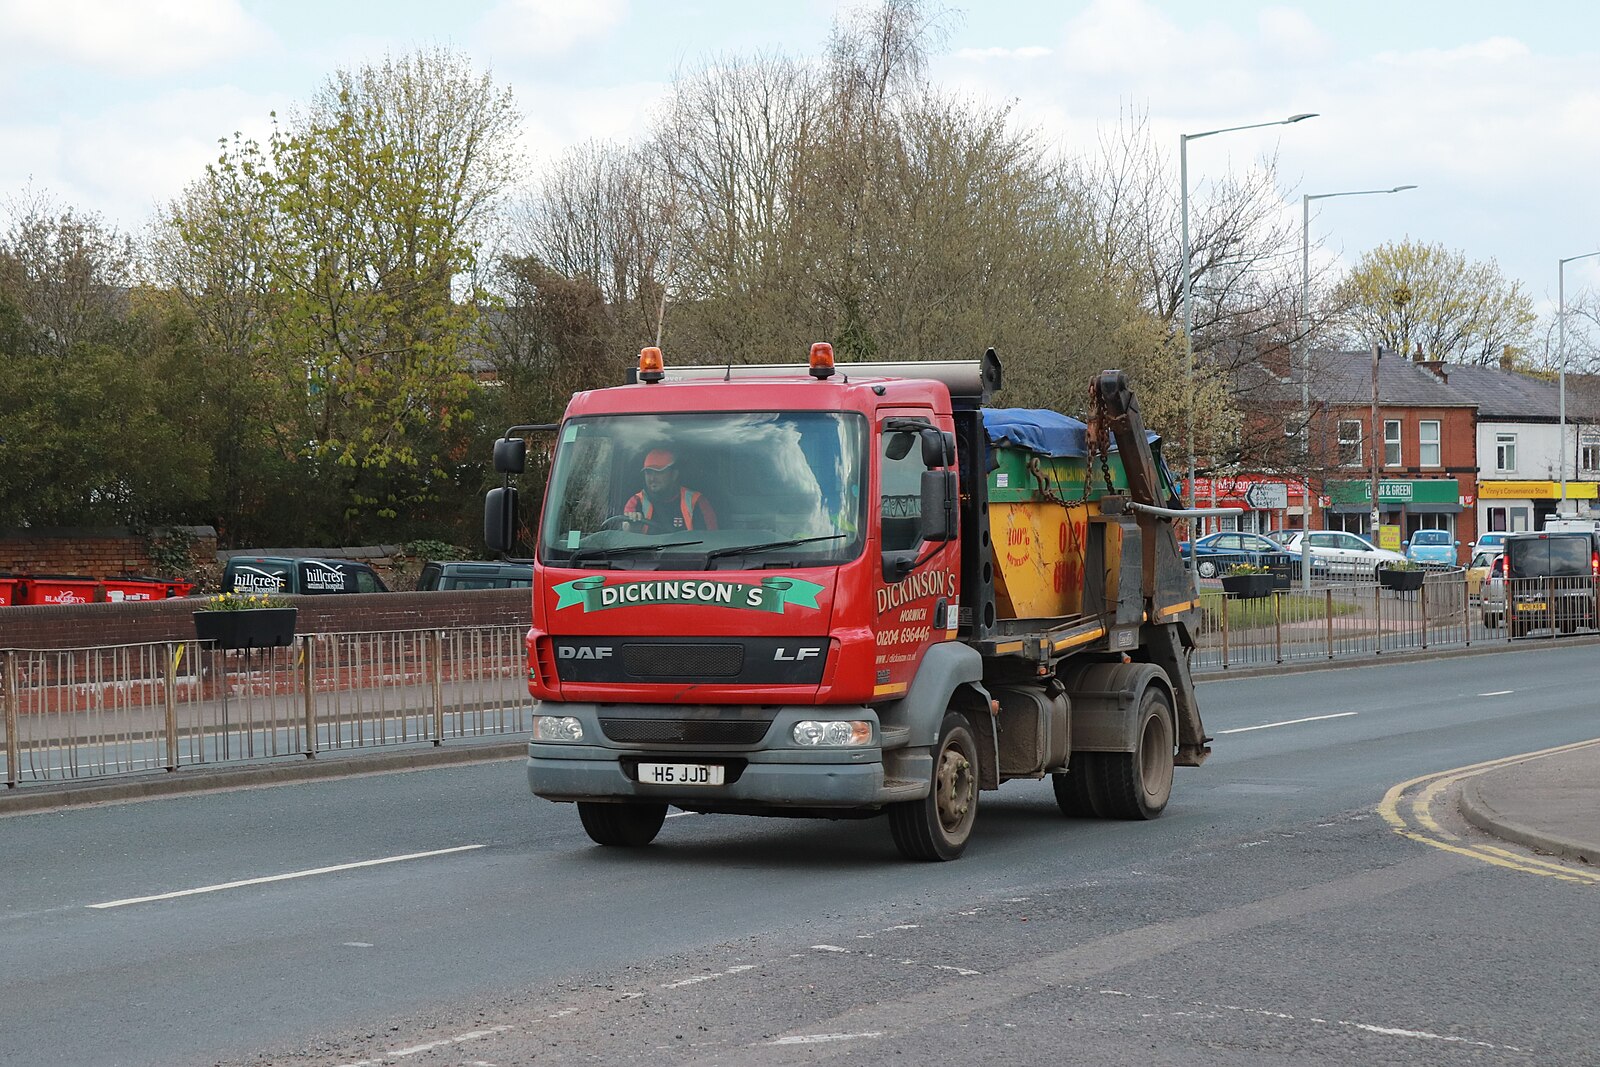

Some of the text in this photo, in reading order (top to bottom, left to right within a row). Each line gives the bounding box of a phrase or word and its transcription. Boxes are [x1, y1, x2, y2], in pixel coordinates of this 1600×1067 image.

[1392, 485, 1410, 496] GREEN
[1486, 488, 1503, 496] Vinny's
[1006, 528, 1030, 546] 100%
[234, 573, 281, 588] hillcrest
[306, 569, 344, 583] hillcrest
[325, 582, 344, 591] hospital
[602, 582, 763, 606] DICKINSON'S
[876, 567, 955, 614] DICKINSON'S
[900, 608, 927, 622] HORWICH
[876, 626, 930, 646] 01204 696446
[558, 646, 820, 661] DAF LF
[655, 766, 708, 782] H5 JJD
